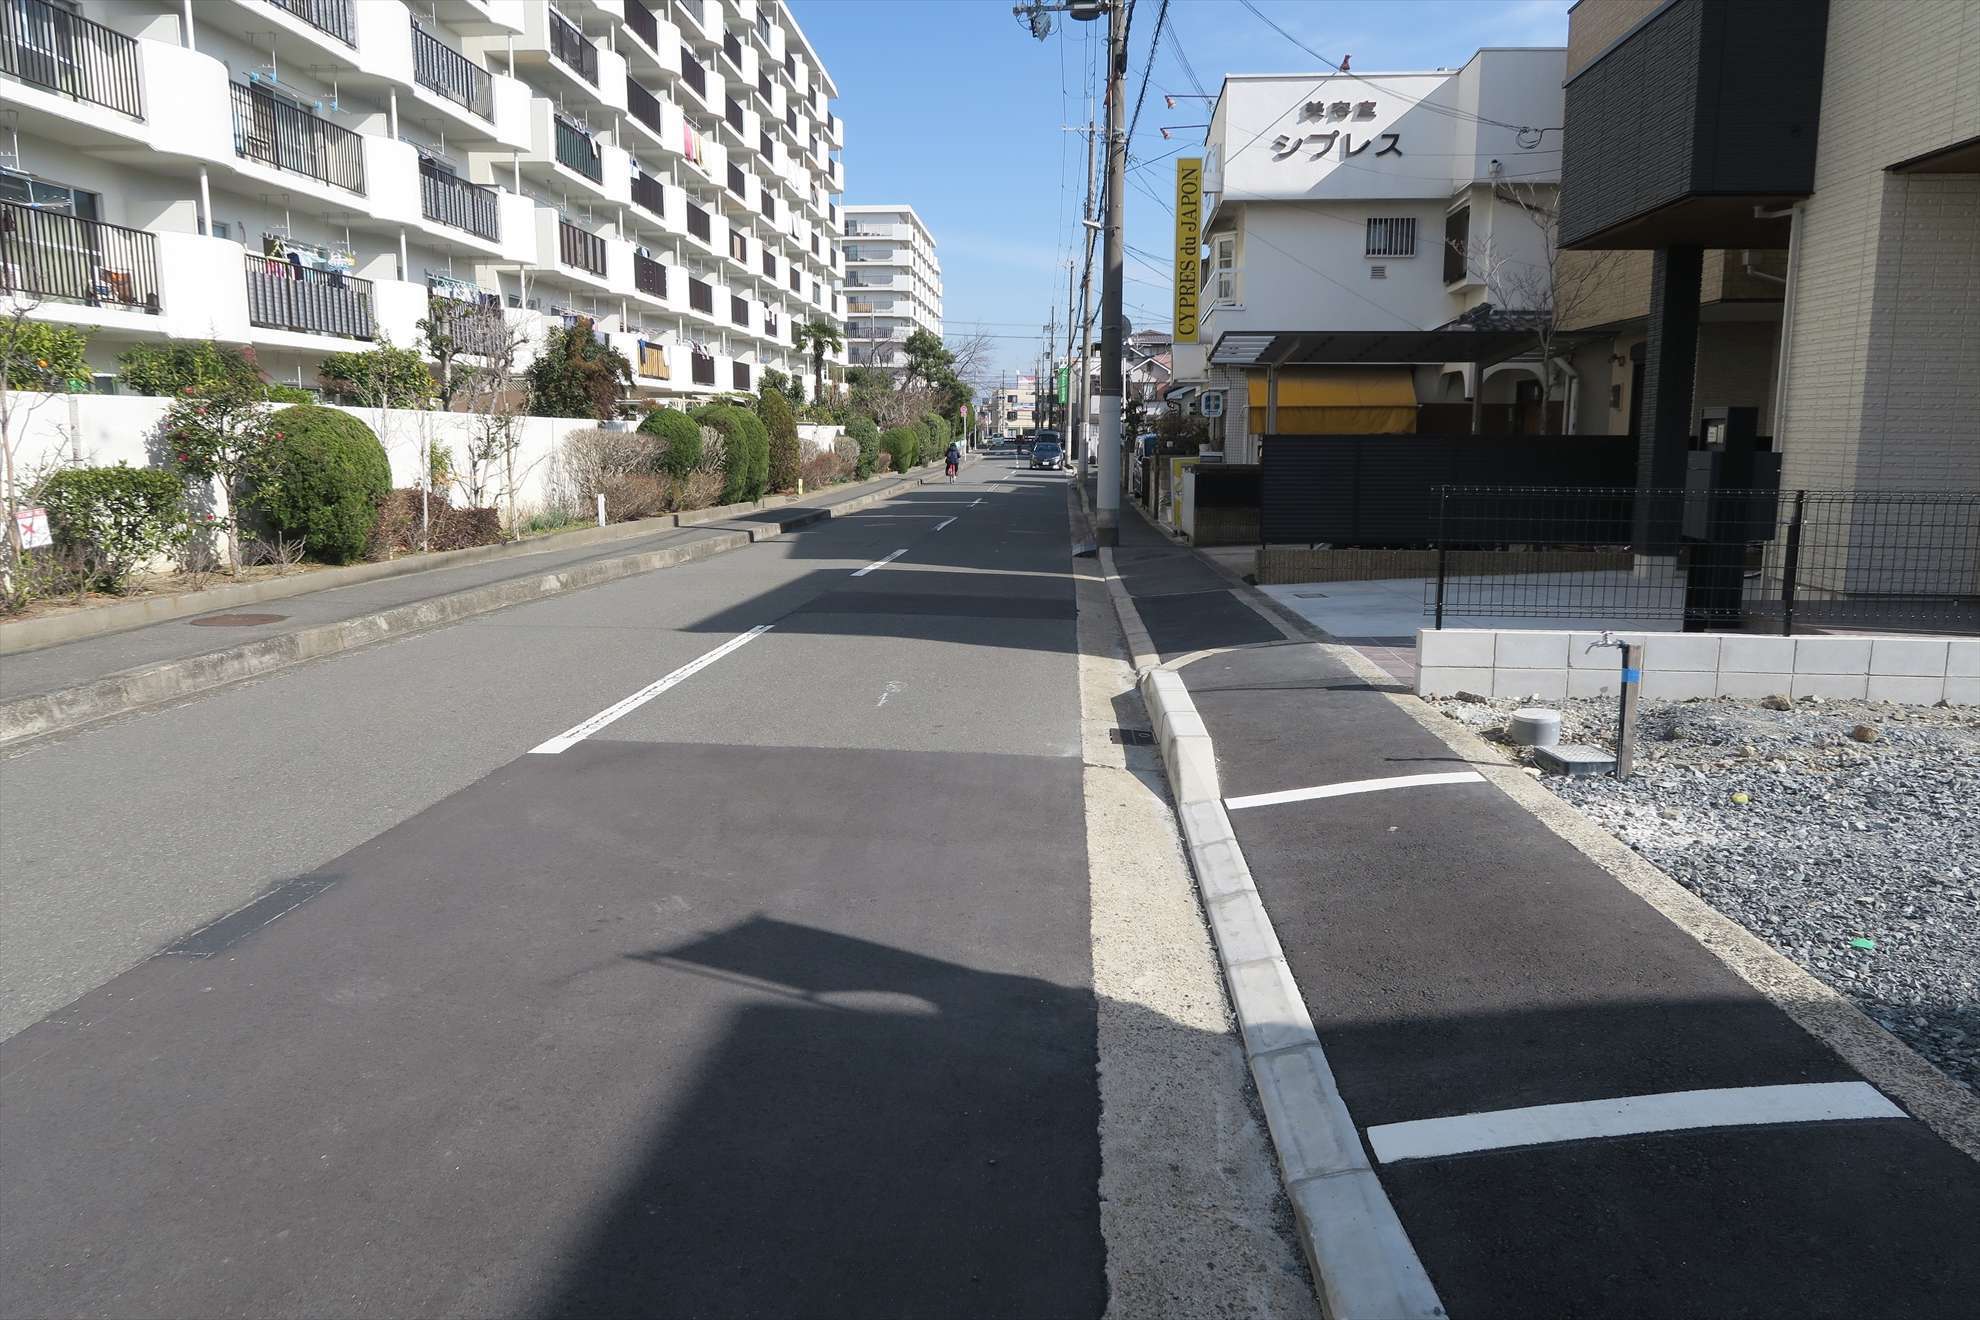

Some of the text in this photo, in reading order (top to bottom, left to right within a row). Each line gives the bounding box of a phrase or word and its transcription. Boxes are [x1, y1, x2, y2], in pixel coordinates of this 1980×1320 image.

[1273, 129, 1402, 160] シプレス
[1179, 167, 1199, 335] CYPRES du JAPON
